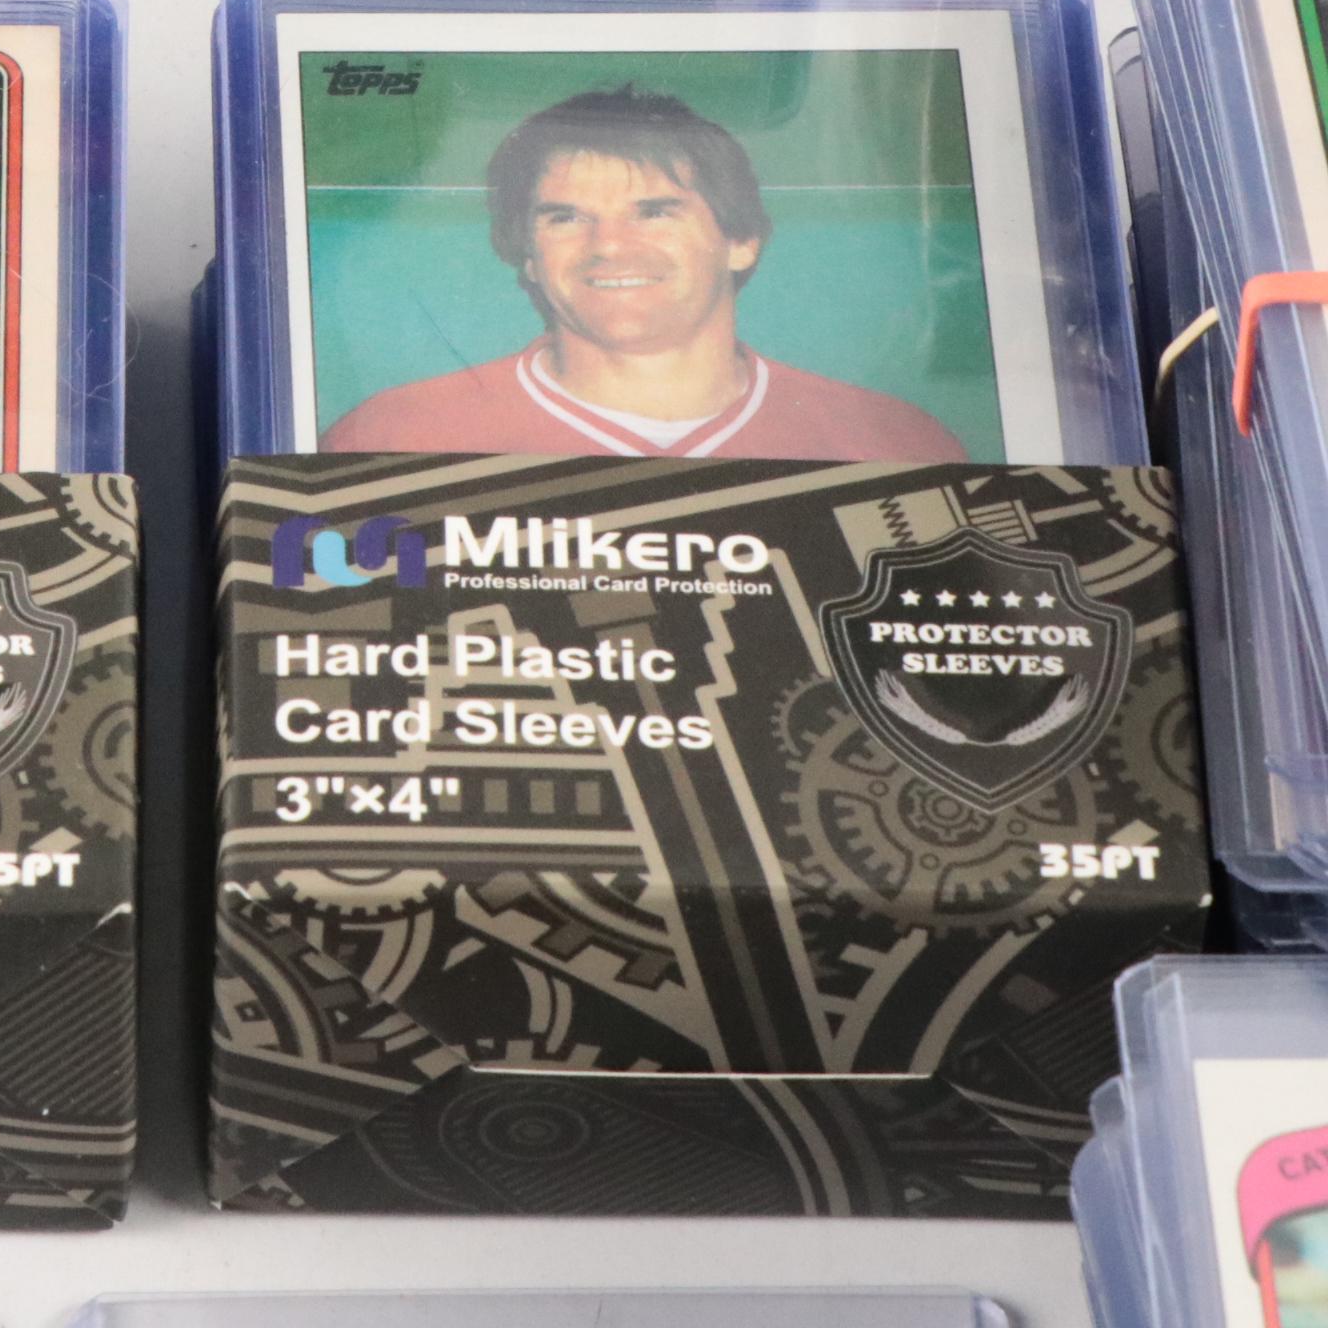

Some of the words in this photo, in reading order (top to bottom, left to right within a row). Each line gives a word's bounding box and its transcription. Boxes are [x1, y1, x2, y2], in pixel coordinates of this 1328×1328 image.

[444, 516, 770, 573] Mlikero
[444, 572, 587, 592] Professional
[593, 575, 648, 592] Card
[655, 577, 772, 595] Protection
[869, 622, 1092, 647] PROTECTOR
[276, 634, 429, 676] Hard
[454, 636, 675, 683] Plastic
[902, 652, 1064, 676] SLEEVES
[275, 699, 431, 743] Card
[455, 700, 714, 751] Sleeves
[1039, 843, 1159, 880] 35PT
